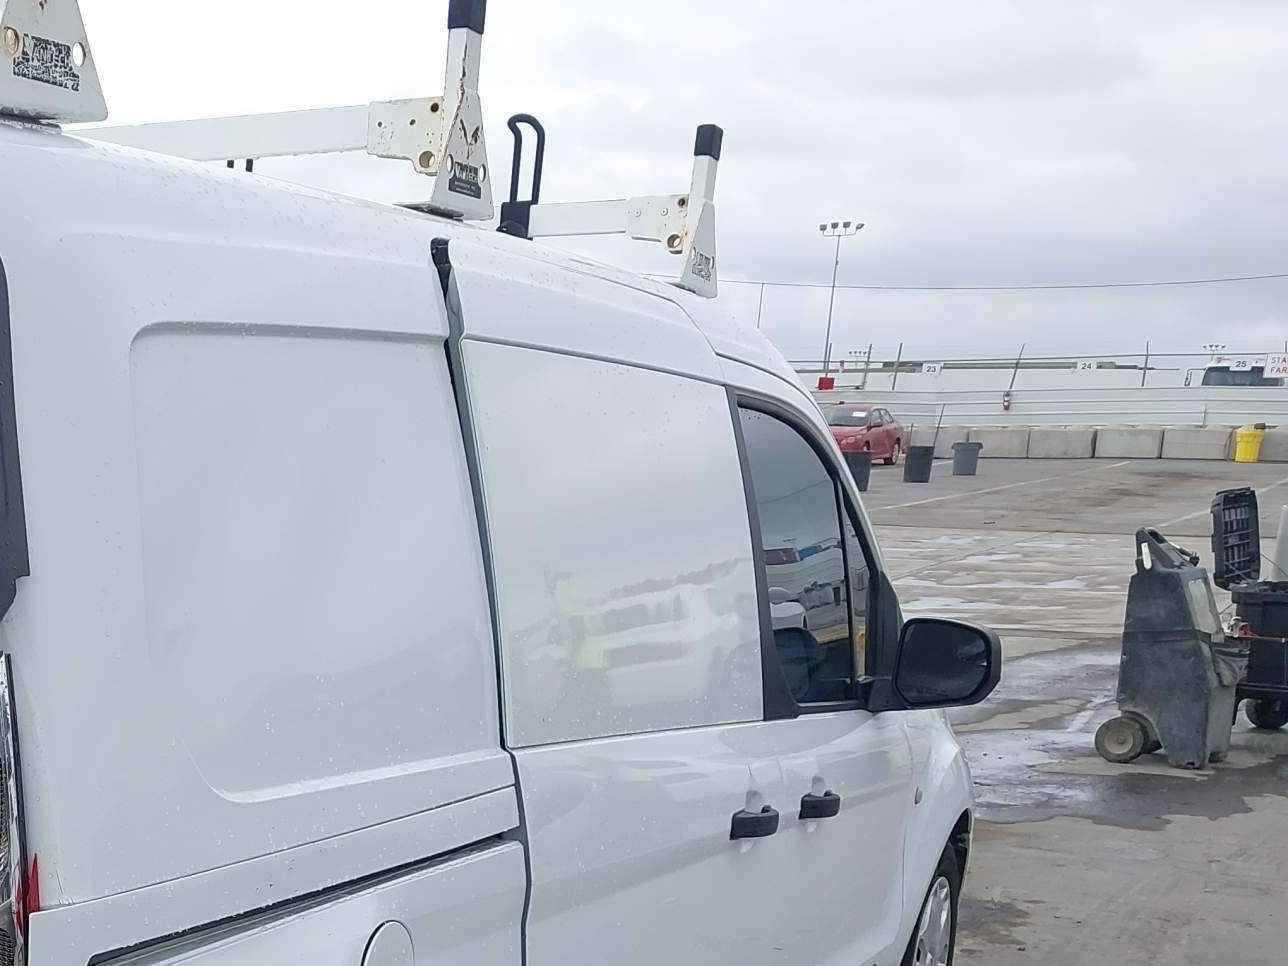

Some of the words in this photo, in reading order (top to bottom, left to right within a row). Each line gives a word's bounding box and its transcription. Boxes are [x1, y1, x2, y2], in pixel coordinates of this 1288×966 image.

[925, 365, 937, 373] 23
[1081, 362, 1092, 370] 24
[1270, 366, 1288, 374] FAR
